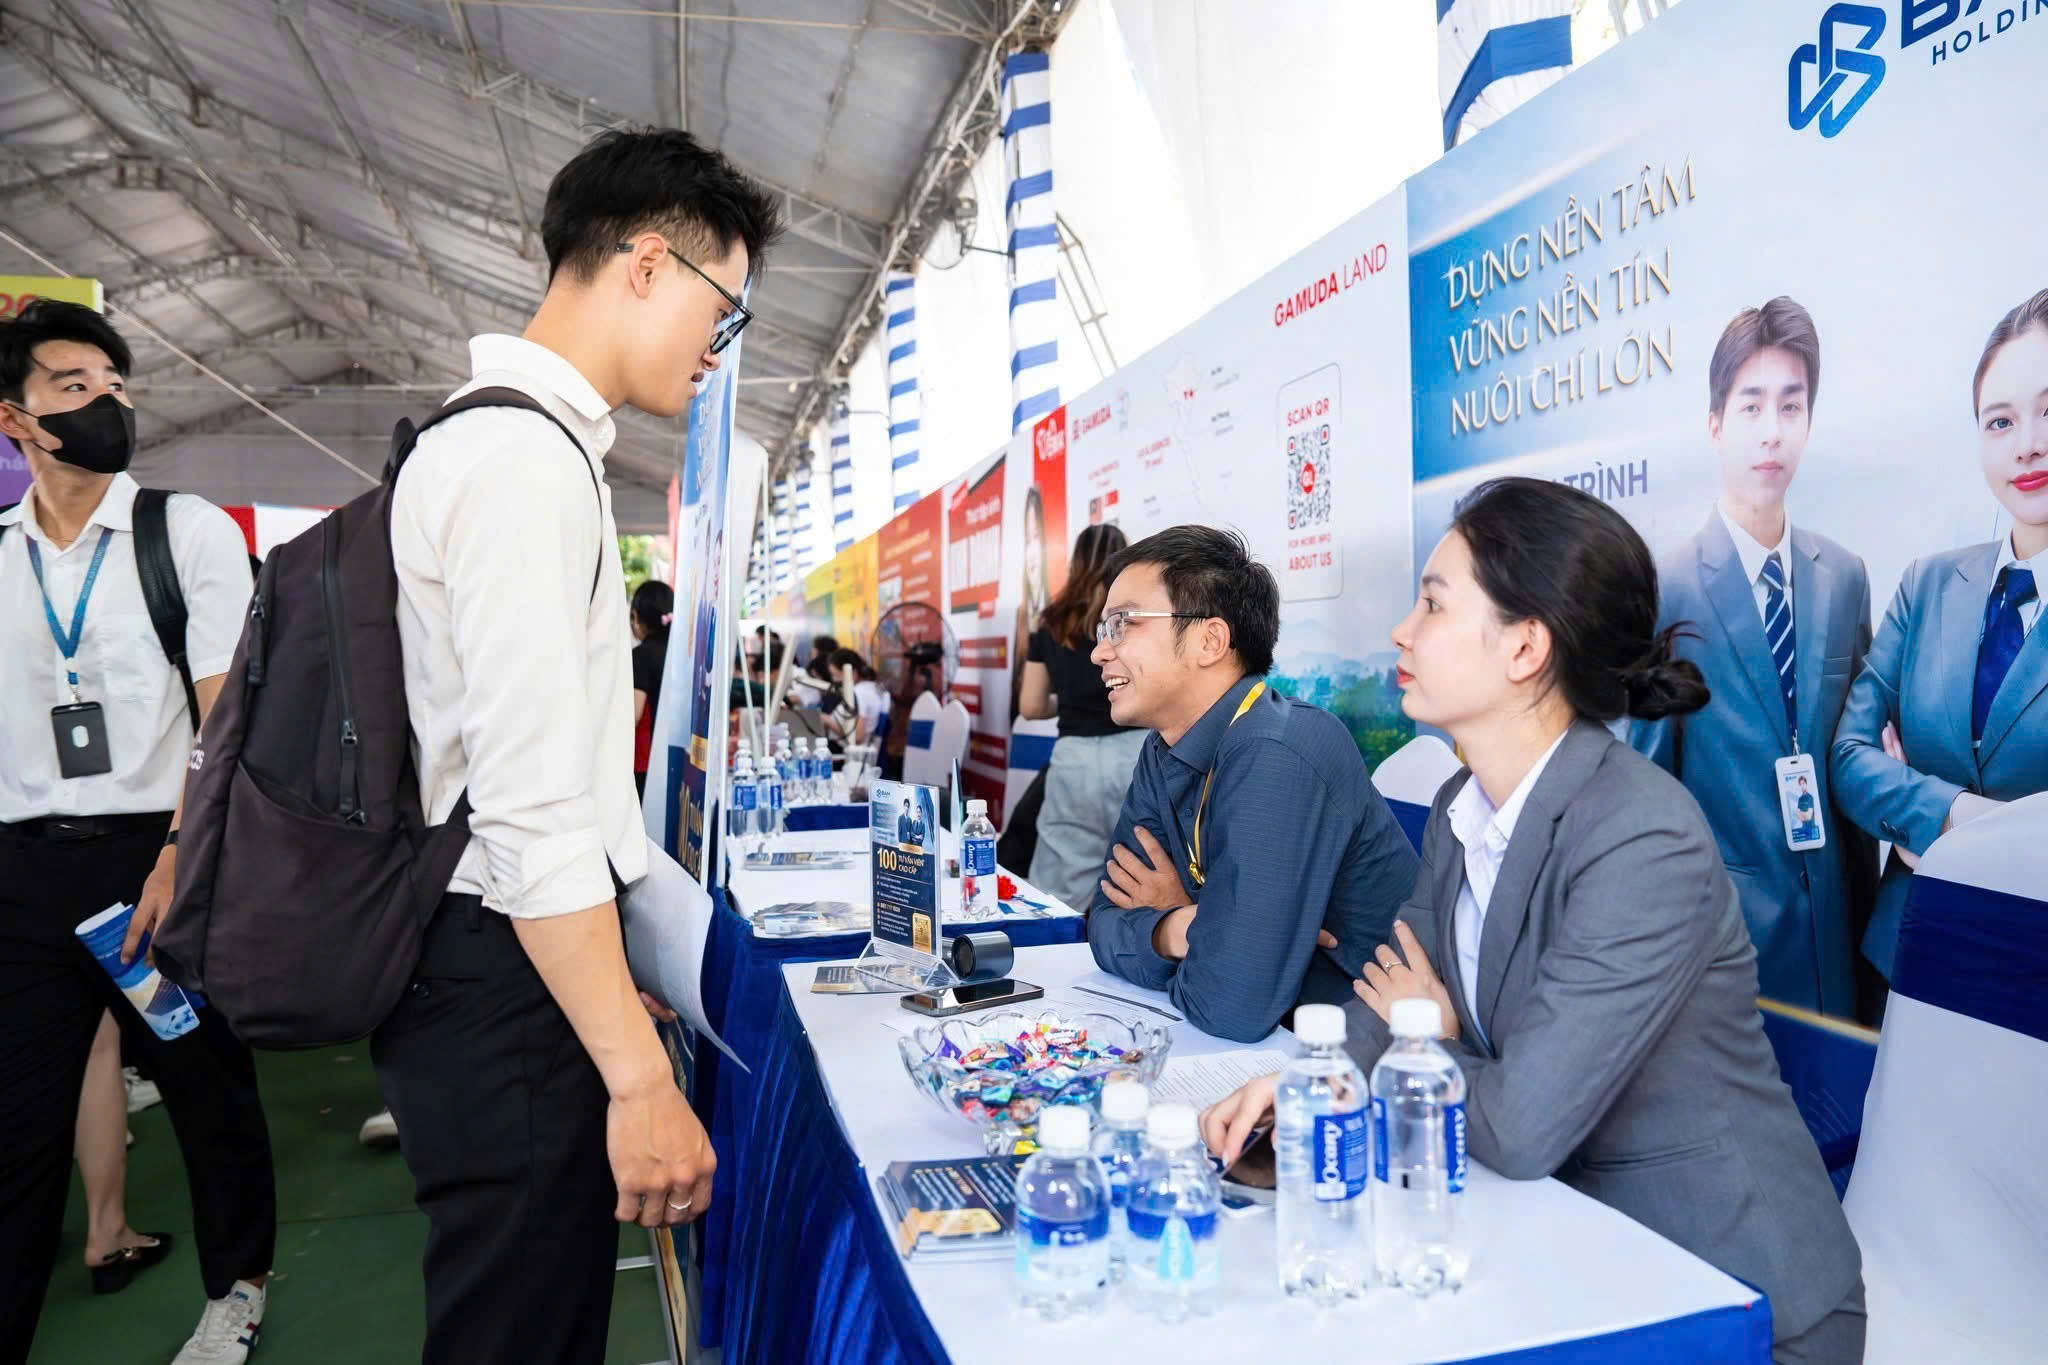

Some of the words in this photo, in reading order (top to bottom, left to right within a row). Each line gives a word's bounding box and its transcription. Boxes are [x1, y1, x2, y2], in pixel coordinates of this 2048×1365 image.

[1539, 194, 1604, 268] NỀN
[1612, 153, 1696, 231] TÂM
[1274, 271, 1339, 327] GAMUDA
[1343, 243, 1388, 290] LAND
[1536, 271, 1600, 341] NỀN
[1609, 245, 1672, 311] TÍN
[1287, 405, 1313, 428] SCAN
[1315, 397, 1330, 416] QR
[1452, 371, 1521, 435] NUÔI
[1530, 346, 1586, 411] CHÍ
[1597, 323, 1673, 395] LỚN
[1288, 555, 1317, 571] ABOUT
[1320, 551, 1332, 567] US
[877, 847, 897, 871] 100
